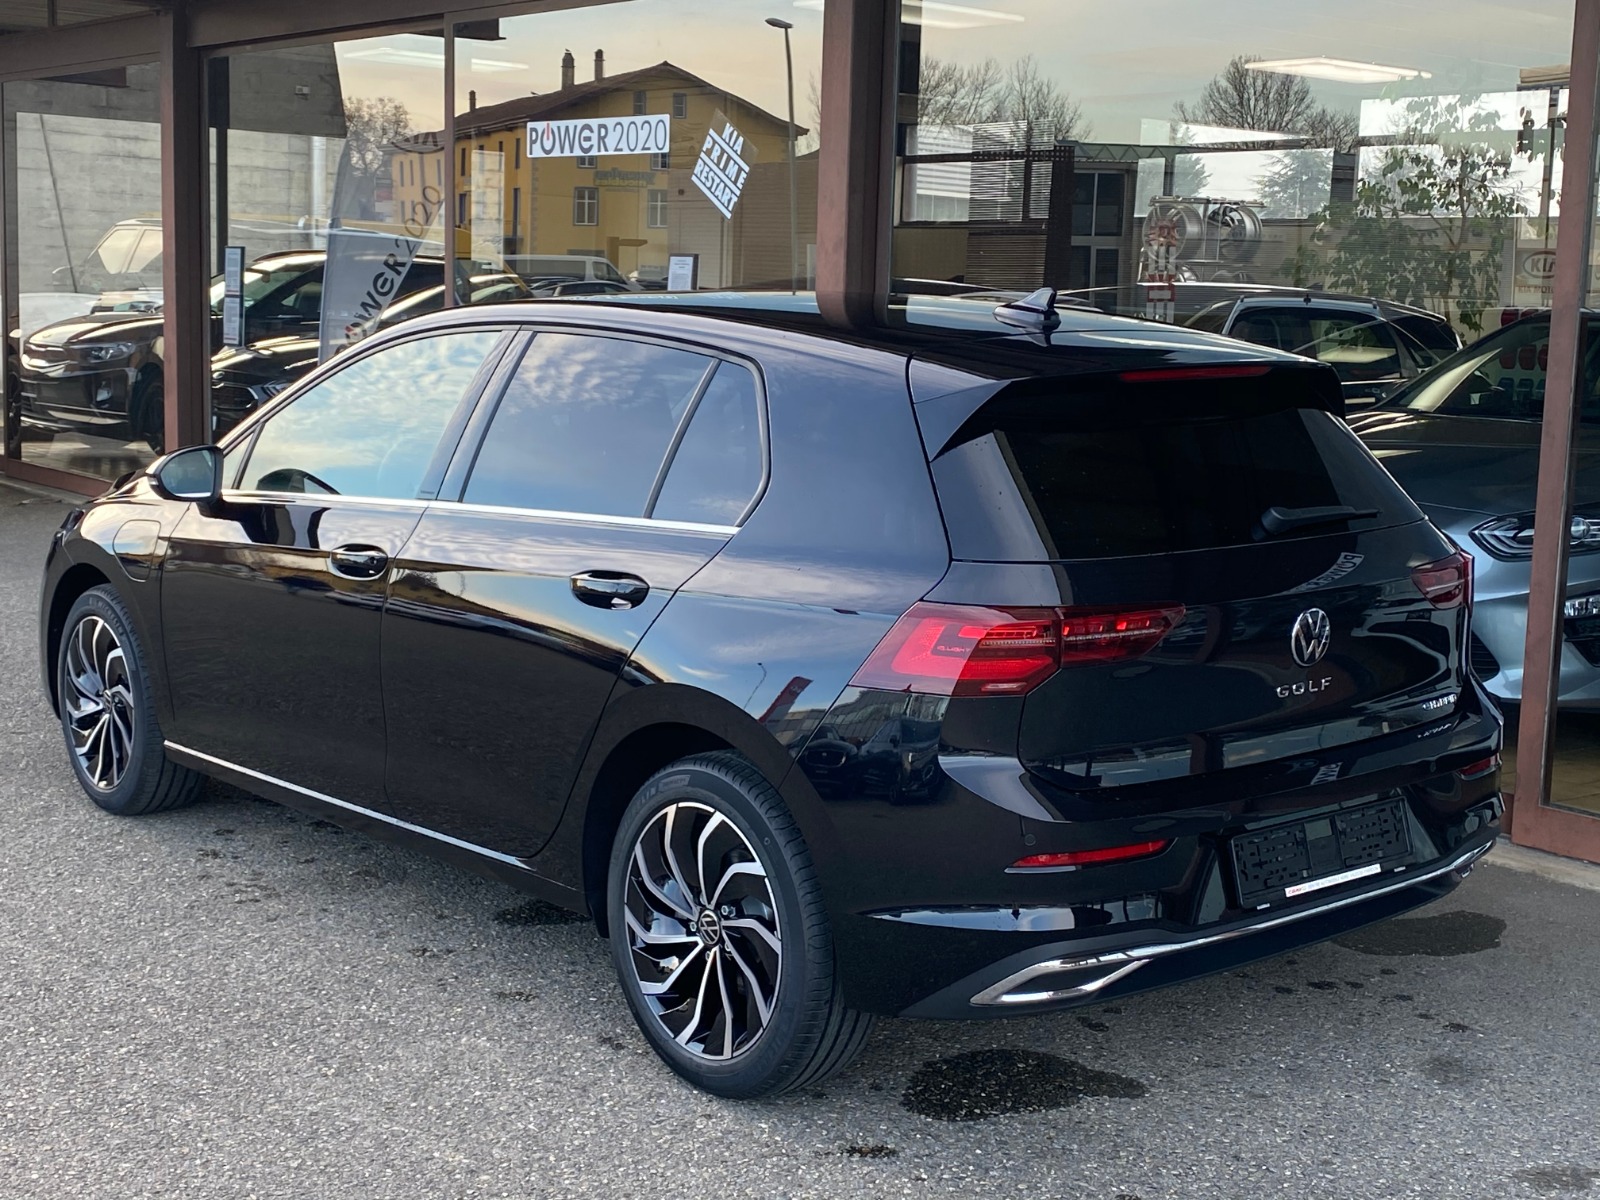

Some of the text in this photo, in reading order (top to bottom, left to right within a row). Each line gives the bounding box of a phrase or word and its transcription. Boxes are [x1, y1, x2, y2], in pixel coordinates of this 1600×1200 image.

[722, 122, 744, 155] KIA
[702, 134, 747, 190] PRIME
[693, 157, 738, 212] RESTART
[1276, 676, 1332, 698] GOLF
